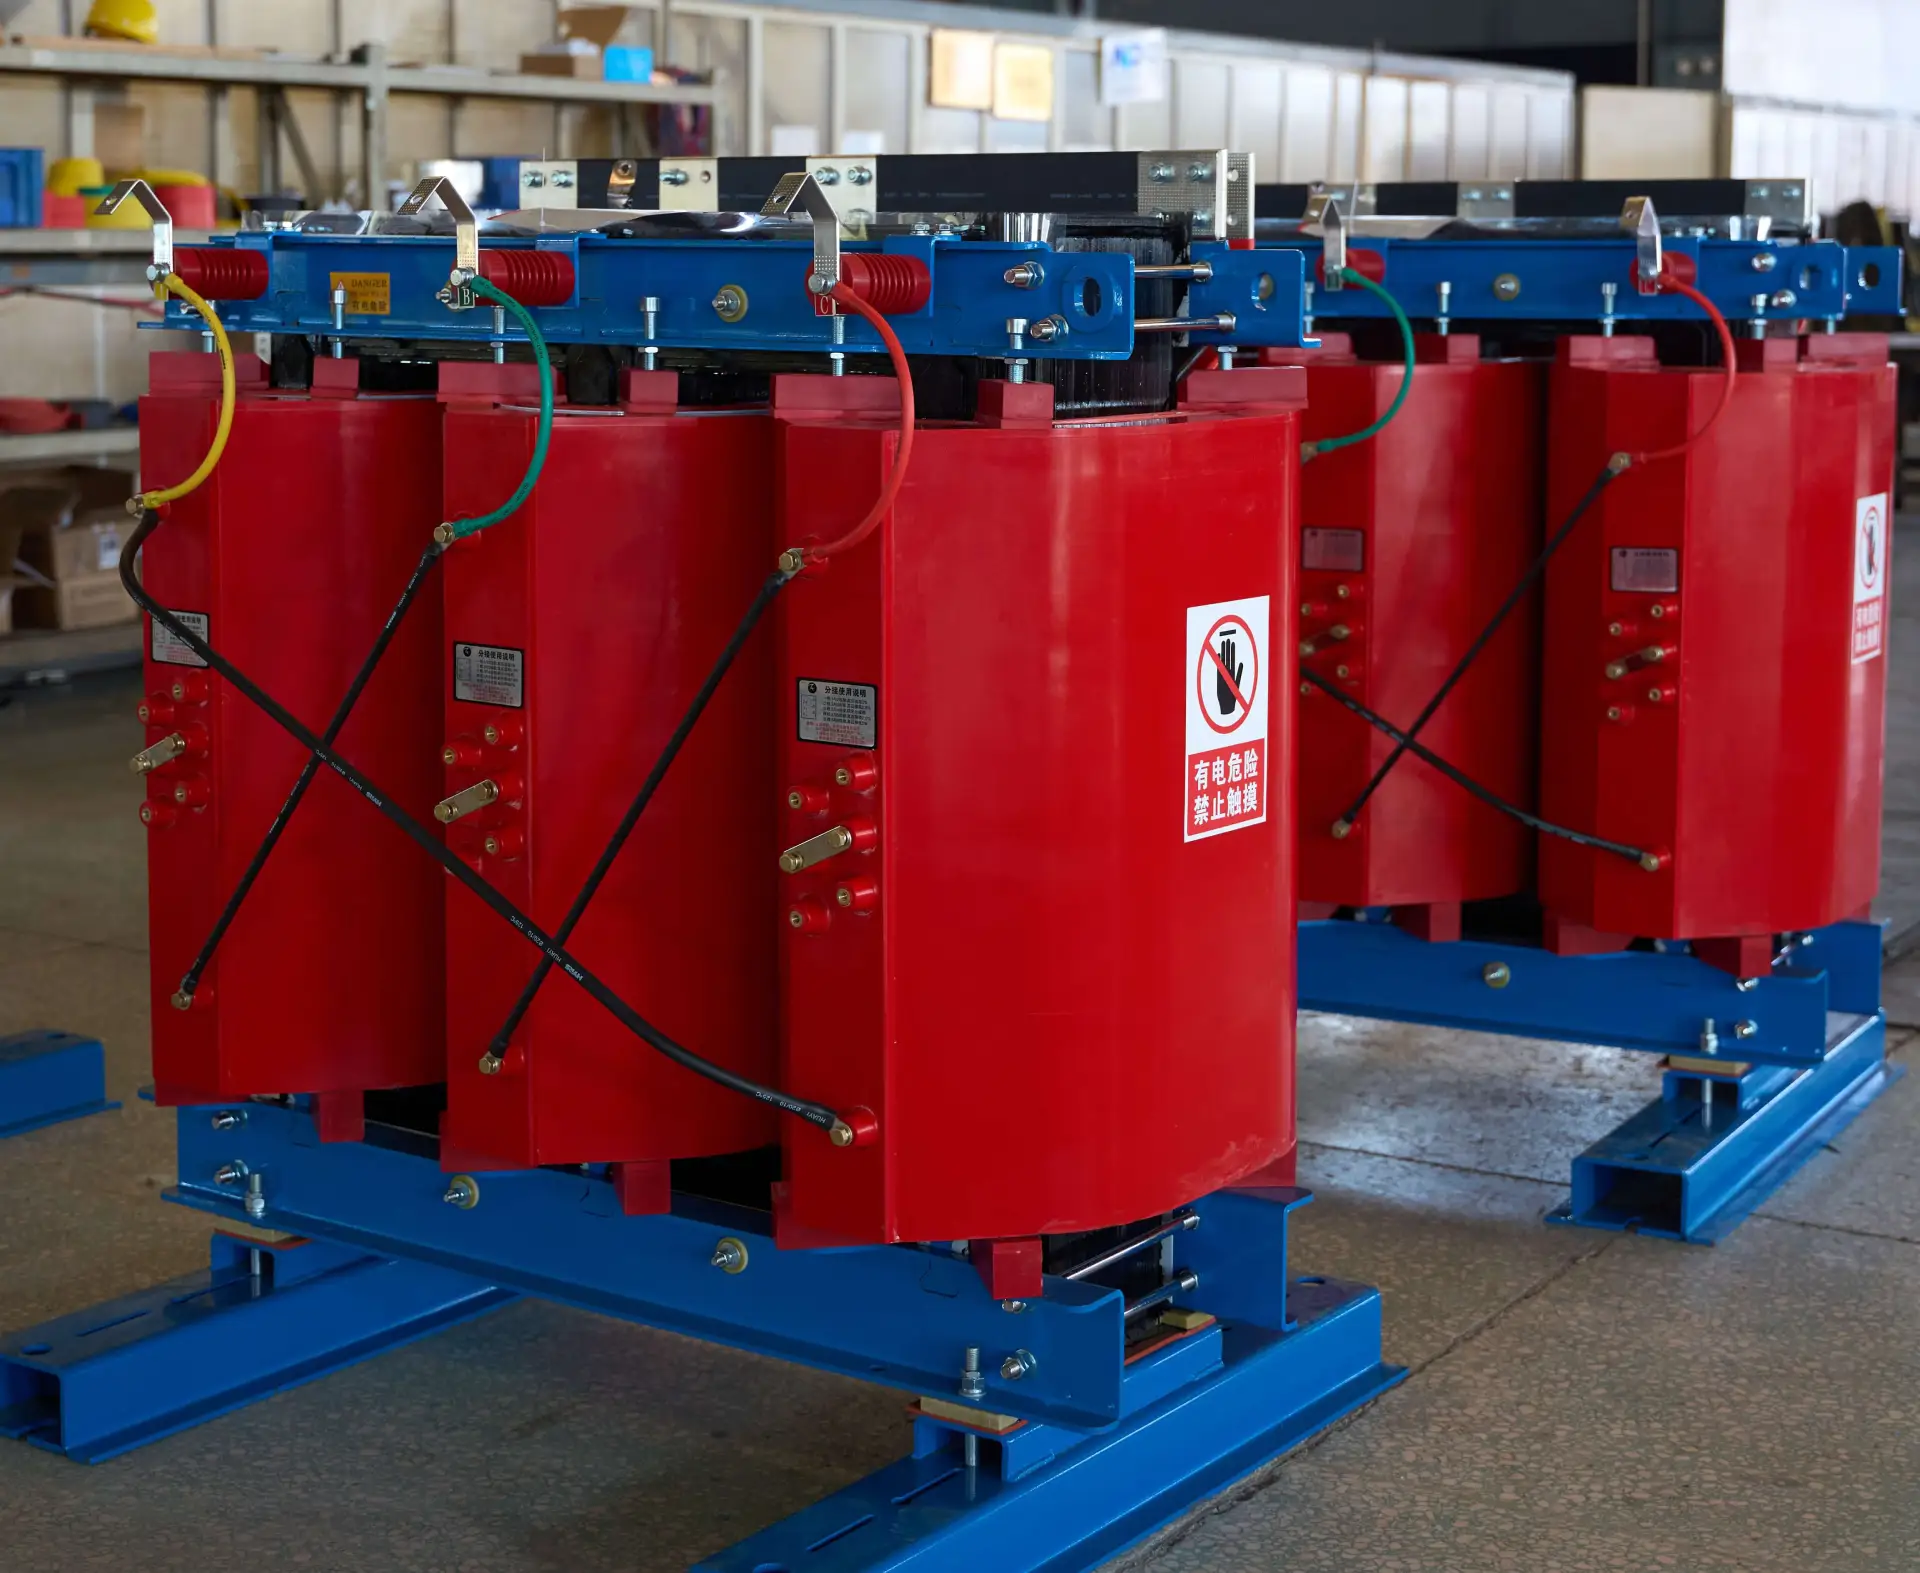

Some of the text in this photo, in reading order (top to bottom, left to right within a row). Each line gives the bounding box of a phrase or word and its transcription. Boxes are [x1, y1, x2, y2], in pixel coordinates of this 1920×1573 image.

[351, 279, 387, 289] DANGER
[463, 288, 470, 305] B
[820, 295, 829, 314] C
[1194, 748, 1259, 790] 有电危险
[1194, 781, 1258, 825] 禁止触摸
[806, 1111, 826, 1123] HUAYI
